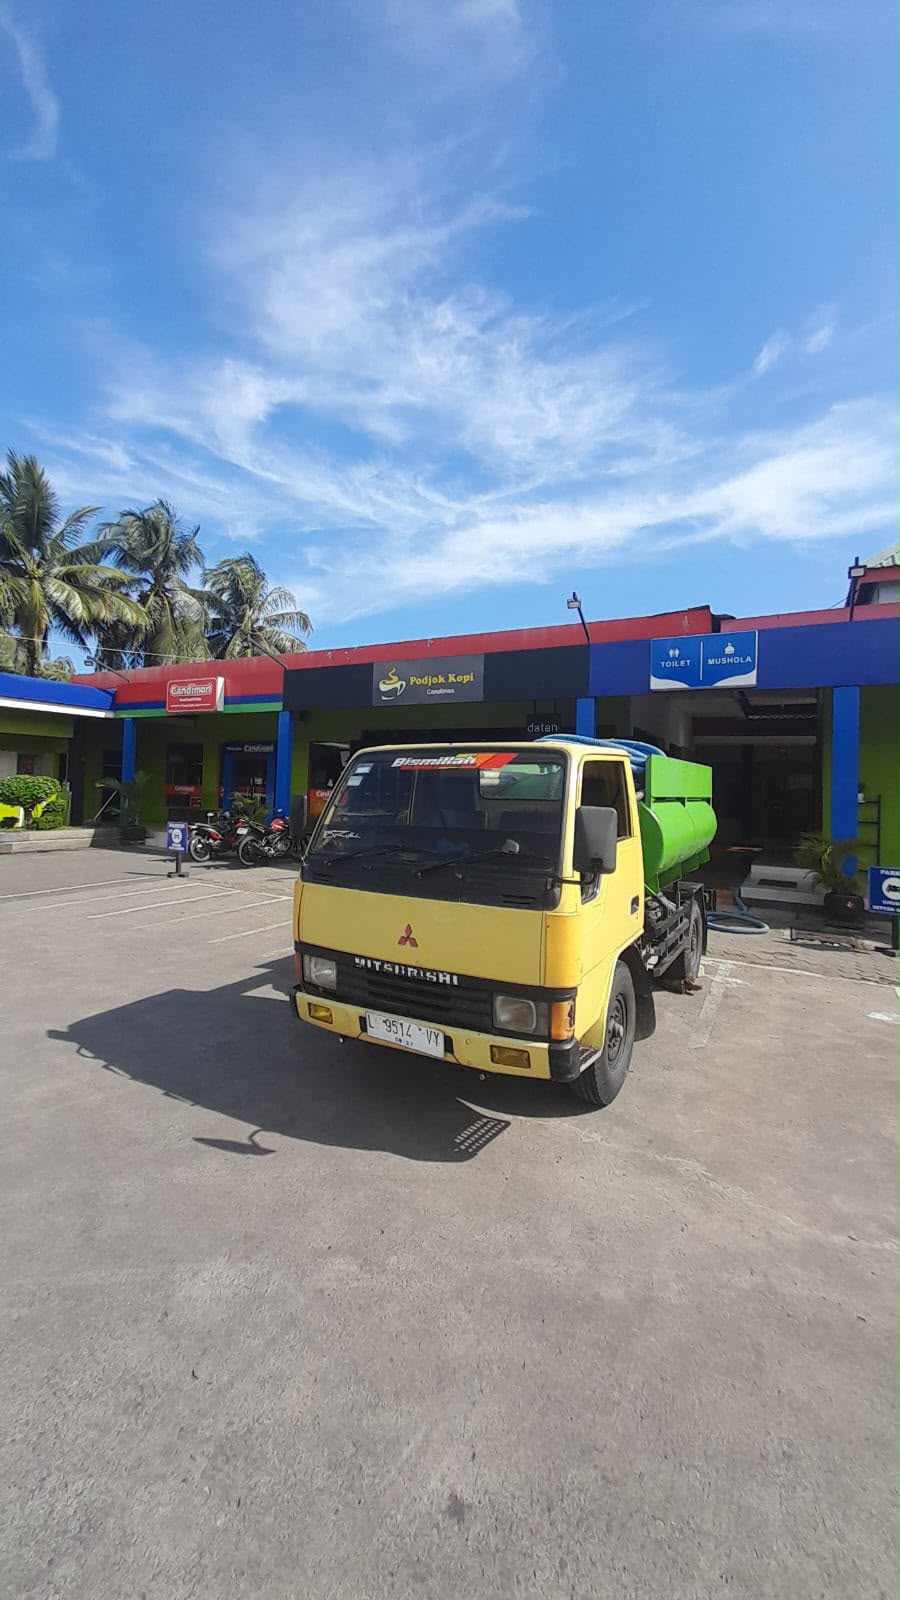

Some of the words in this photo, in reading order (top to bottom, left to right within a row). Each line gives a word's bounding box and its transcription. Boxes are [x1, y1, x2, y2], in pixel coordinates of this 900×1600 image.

[661, 660, 691, 668] TOILET
[708, 656, 752, 665] MUSHOLA
[409, 675, 446, 686] Podjok
[448, 672, 474, 684] Kopi
[391, 756, 477, 767] Bismillah
[367, 1014, 375, 1029] L
[384, 1018, 412, 1038] 9514
[426, 1029, 440, 1047] VY
